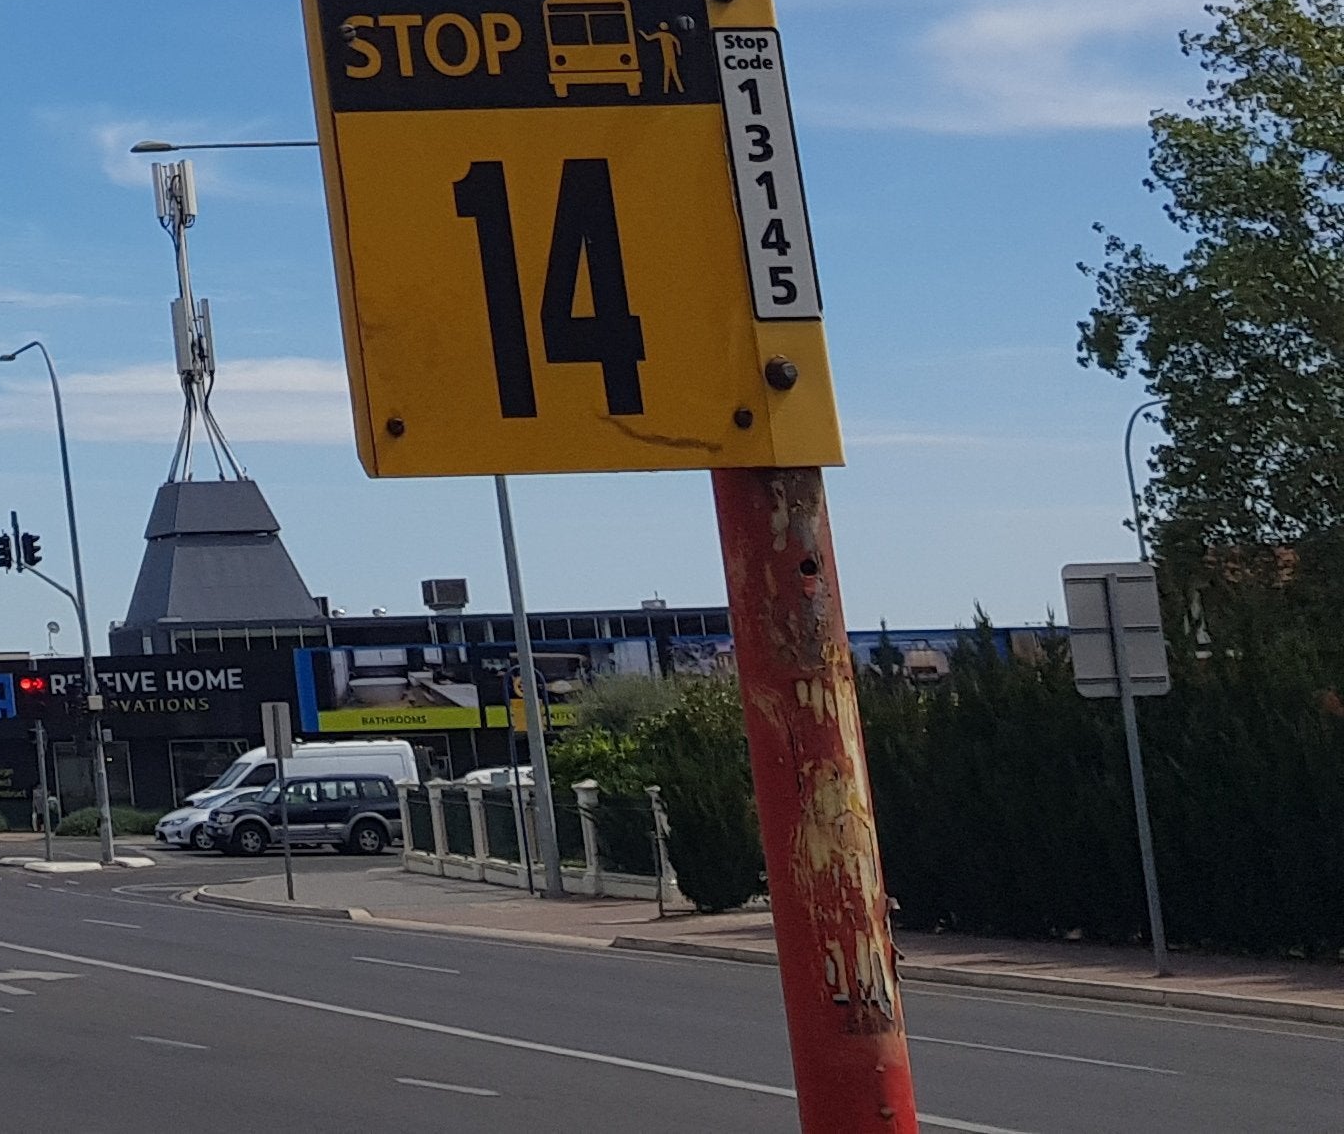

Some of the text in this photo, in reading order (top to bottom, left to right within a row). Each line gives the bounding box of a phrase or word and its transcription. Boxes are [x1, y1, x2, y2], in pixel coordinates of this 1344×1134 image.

[344, 12, 523, 79] STOP
[723, 35, 769, 53] Stop
[723, 54, 774, 71] Code
[452, 158, 647, 419] 14
[166, 668, 244, 692] HOME
[112, 697, 210, 713] VATIONS
[362, 714, 427, 726] BATHROOMS
